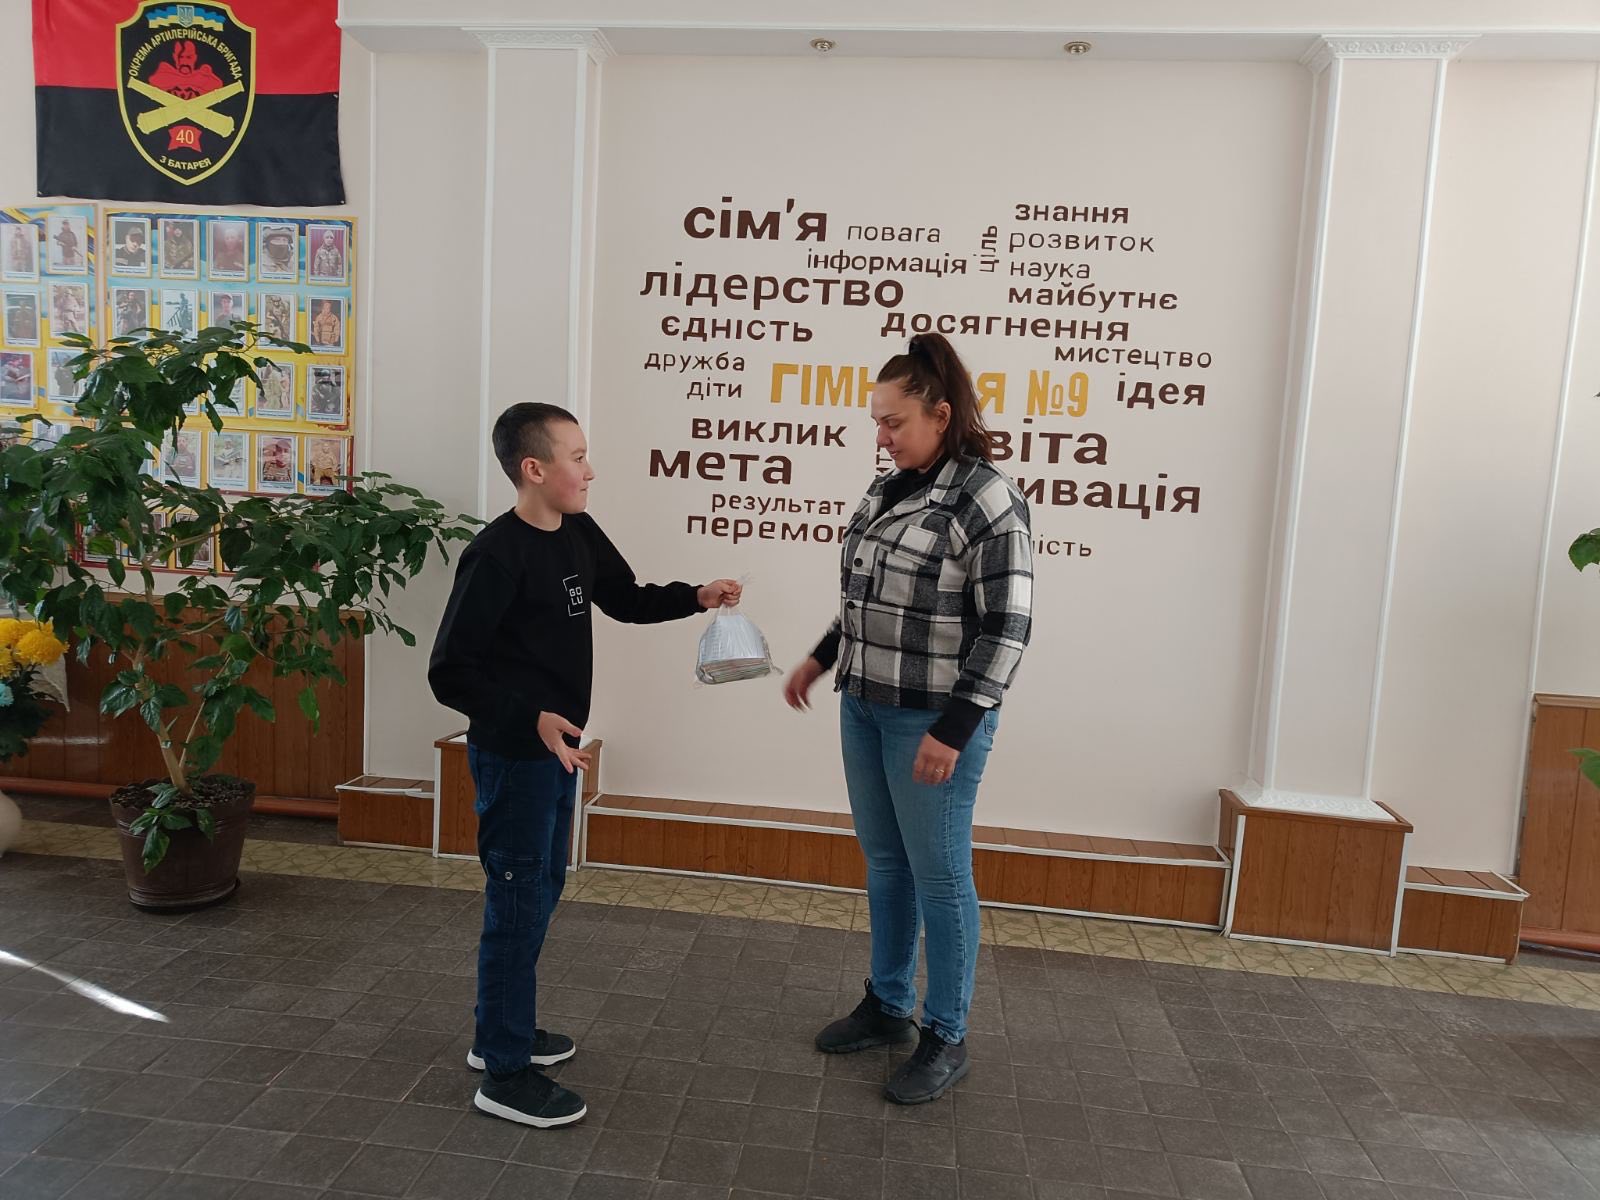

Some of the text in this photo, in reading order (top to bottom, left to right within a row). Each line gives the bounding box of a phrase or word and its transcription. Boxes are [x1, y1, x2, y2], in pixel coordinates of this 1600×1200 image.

[128, 28, 243, 80] ОКРЕМА АРТИЛЕРІЙСЬКА БРИГАДА
[175, 129, 194, 144] 40
[167, 158, 212, 170] БАТАРЕЯ
[684, 196, 827, 242] сім'я
[1015, 203, 1129, 224] знання
[847, 225, 940, 243] повага
[1009, 232, 1155, 253] розвиток
[973, 225, 1000, 273] ціль
[807, 248, 967, 278] інформація
[1010, 261, 1091, 282] наука
[640, 261, 904, 310] лідерство
[1008, 282, 1178, 313] майбутнє
[661, 315, 813, 342] єдність
[881, 312, 1129, 342] досягнення
[644, 351, 745, 374] дружба
[1054, 346, 1212, 370] мистецтво
[687, 377, 742, 400] діти
[1116, 372, 1206, 409] ідея
[691, 418, 847, 447] виклик
[649, 449, 792, 484] мета
[711, 493, 846, 516] результат
